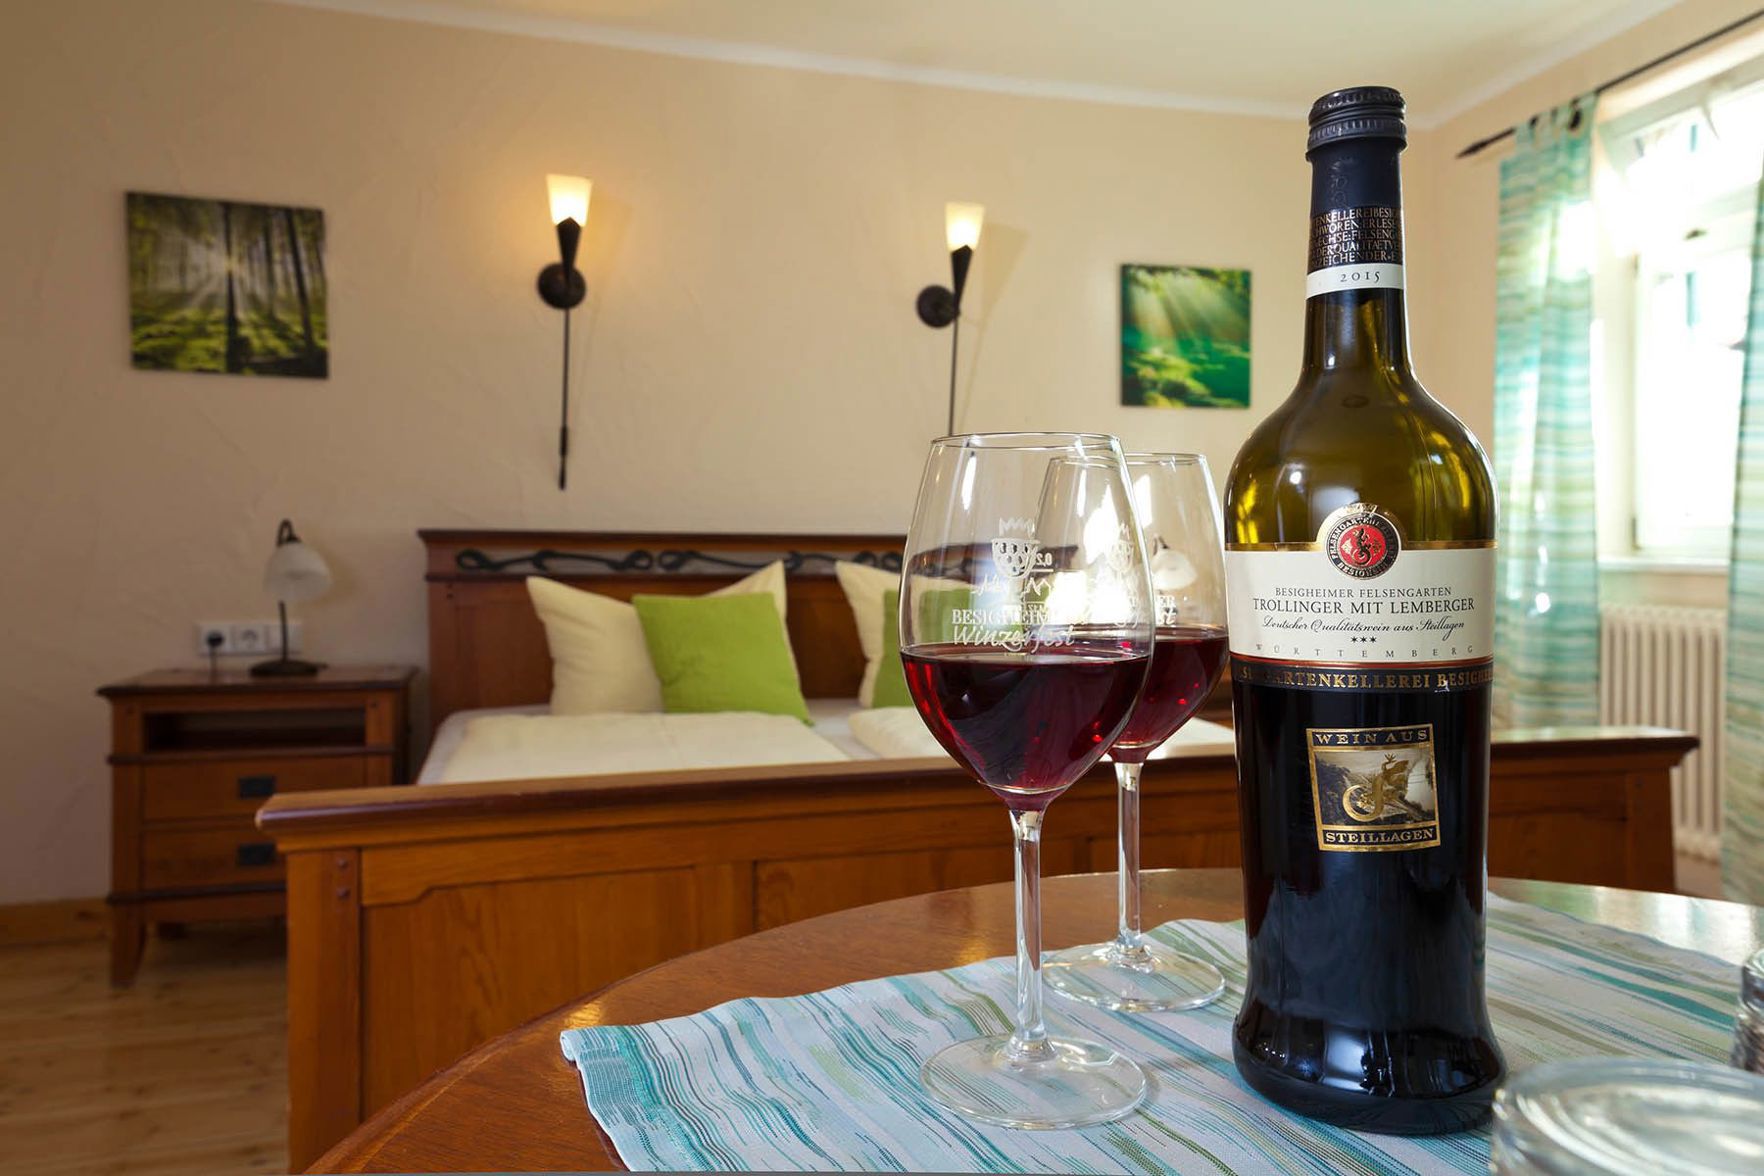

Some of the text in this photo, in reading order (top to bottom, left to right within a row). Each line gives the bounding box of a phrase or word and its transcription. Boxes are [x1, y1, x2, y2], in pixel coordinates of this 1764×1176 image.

[1340, 271, 1380, 283] 2015
[1275, 586, 1452, 598] BESIGHEIMER FELSENGARTEN
[1253, 597, 1475, 614] TROLLINGER MIT LEMBERGER
[1261, 614, 1465, 641] Deutscher Qualitätswein aus Steillagen
[952, 624, 1075, 653] Winzerfest
[1315, 729, 1428, 745] WEIN AUS
[1325, 828, 1434, 843] STEILLAGEN
